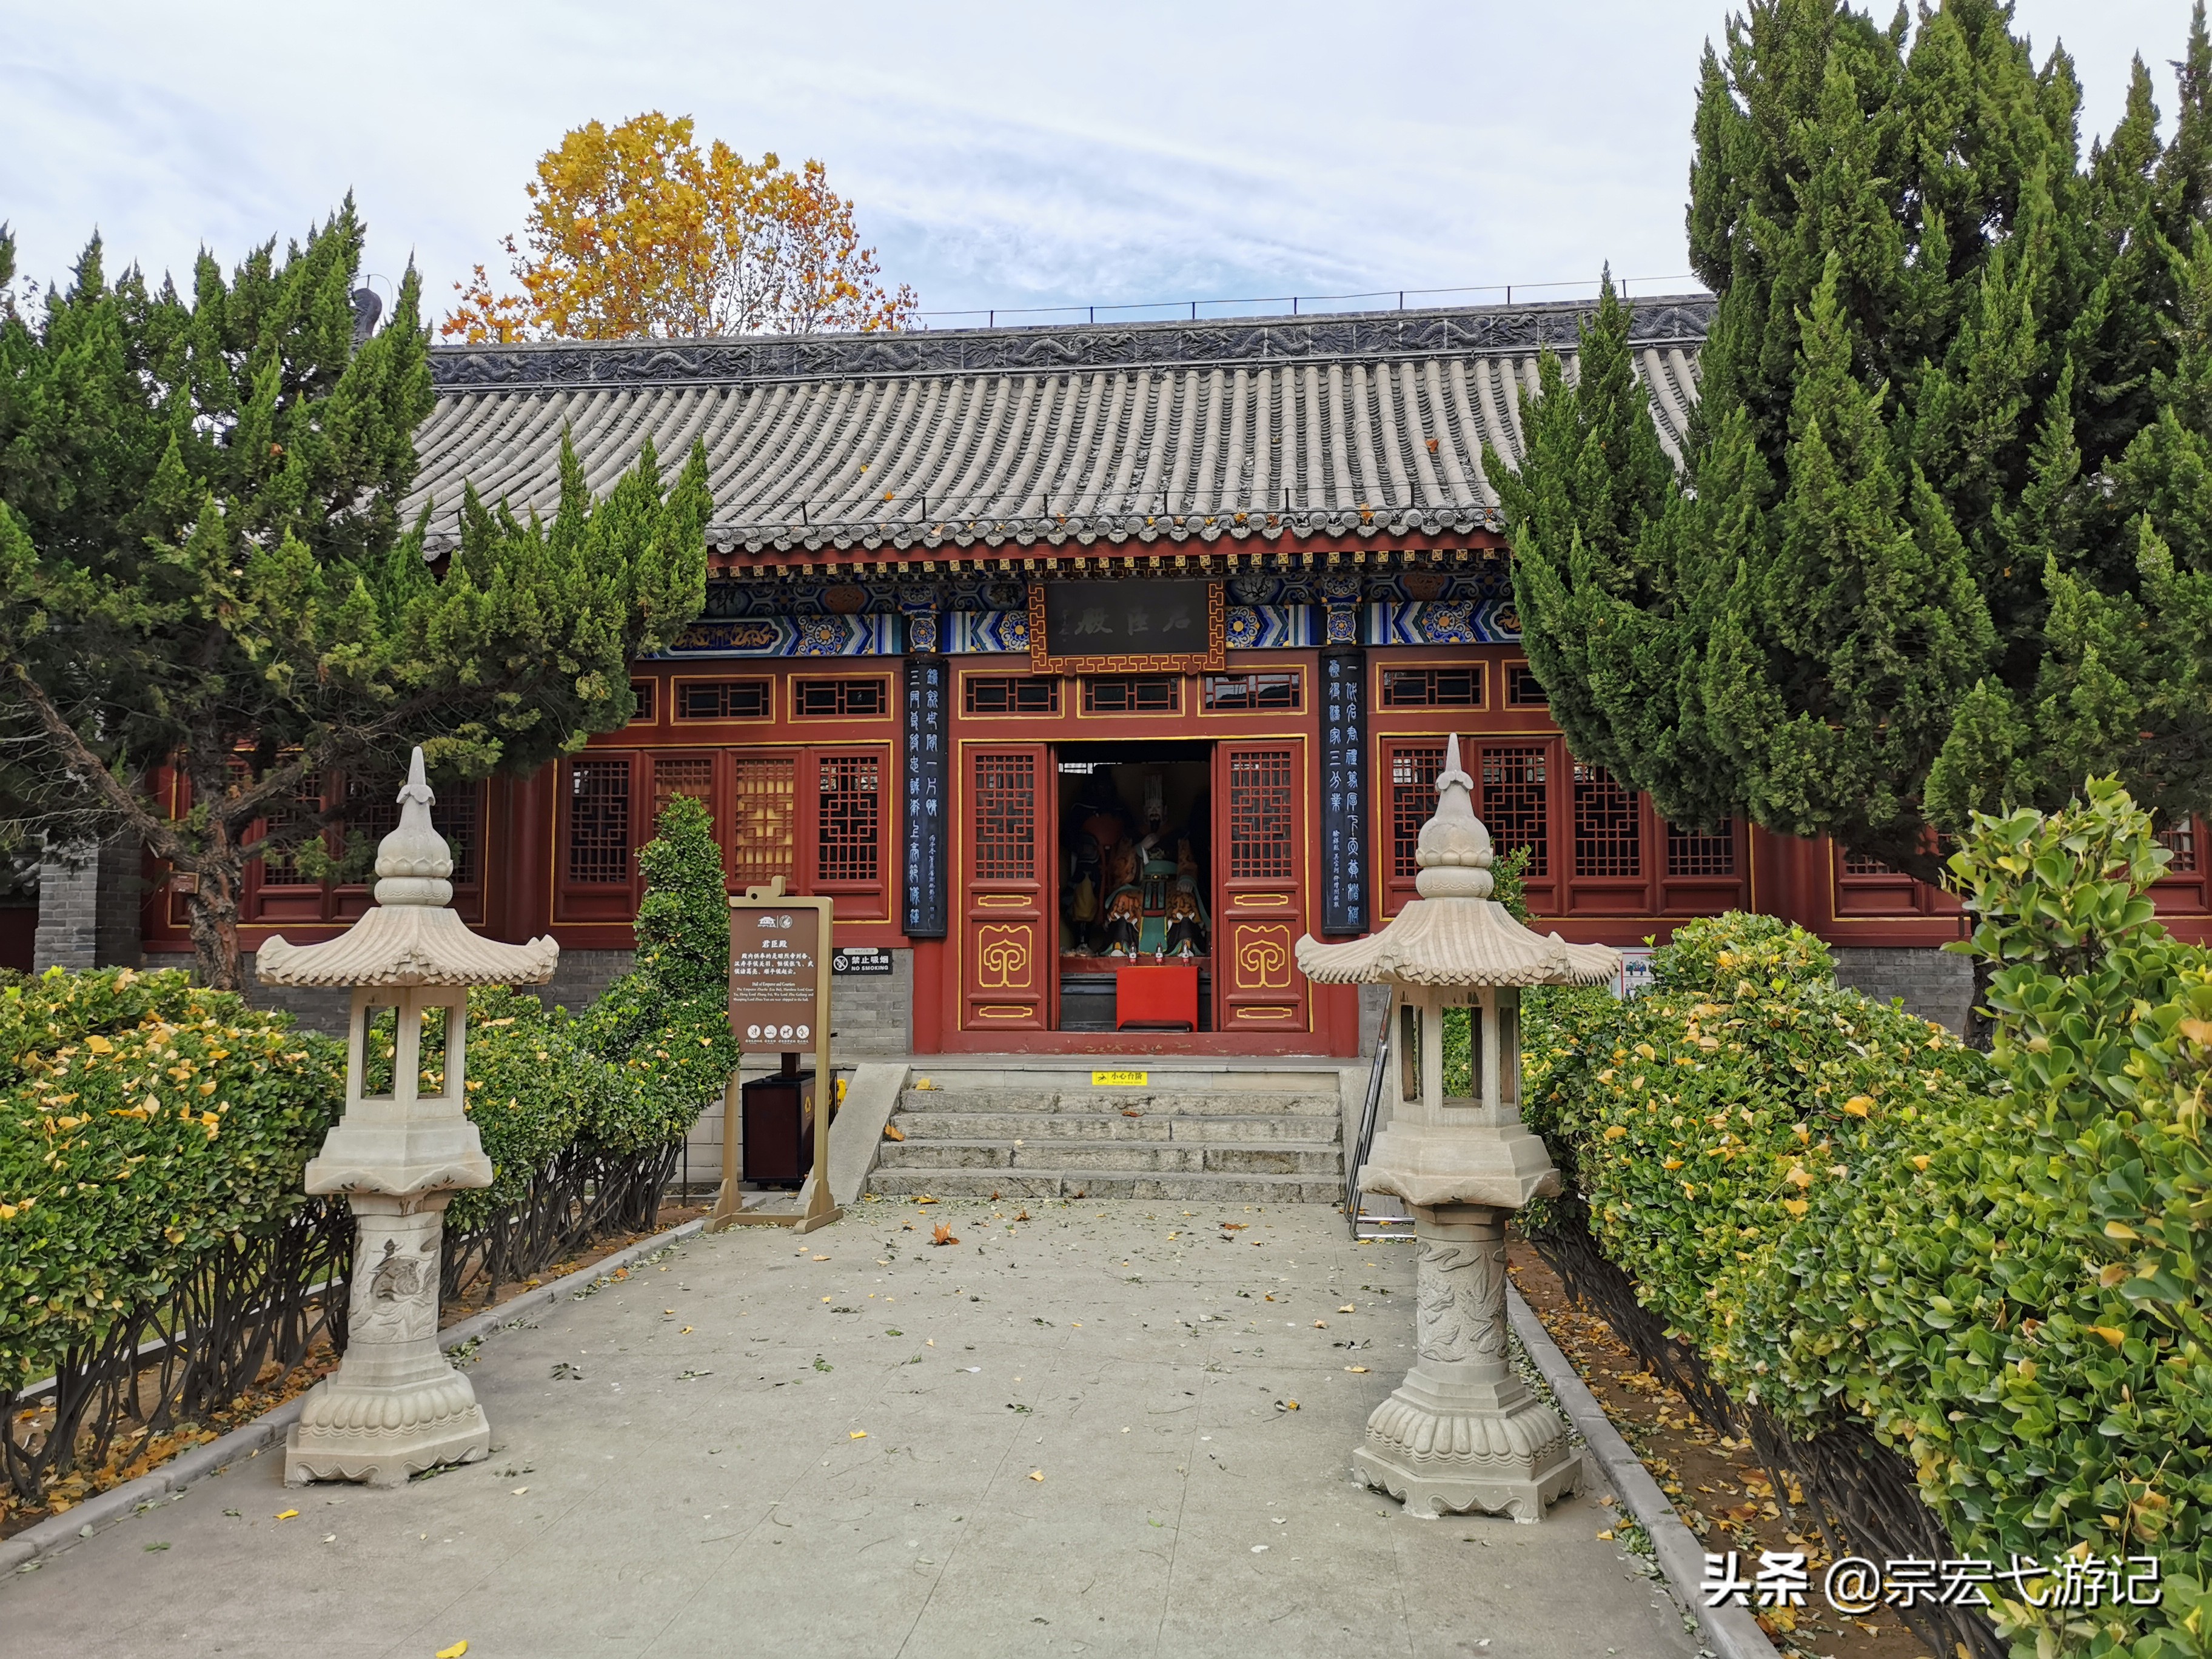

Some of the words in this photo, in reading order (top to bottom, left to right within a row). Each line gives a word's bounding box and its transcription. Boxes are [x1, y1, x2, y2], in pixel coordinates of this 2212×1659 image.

[762, 940, 788, 948] 君臣殿
[851, 956, 889, 964] 禁止吸烟
